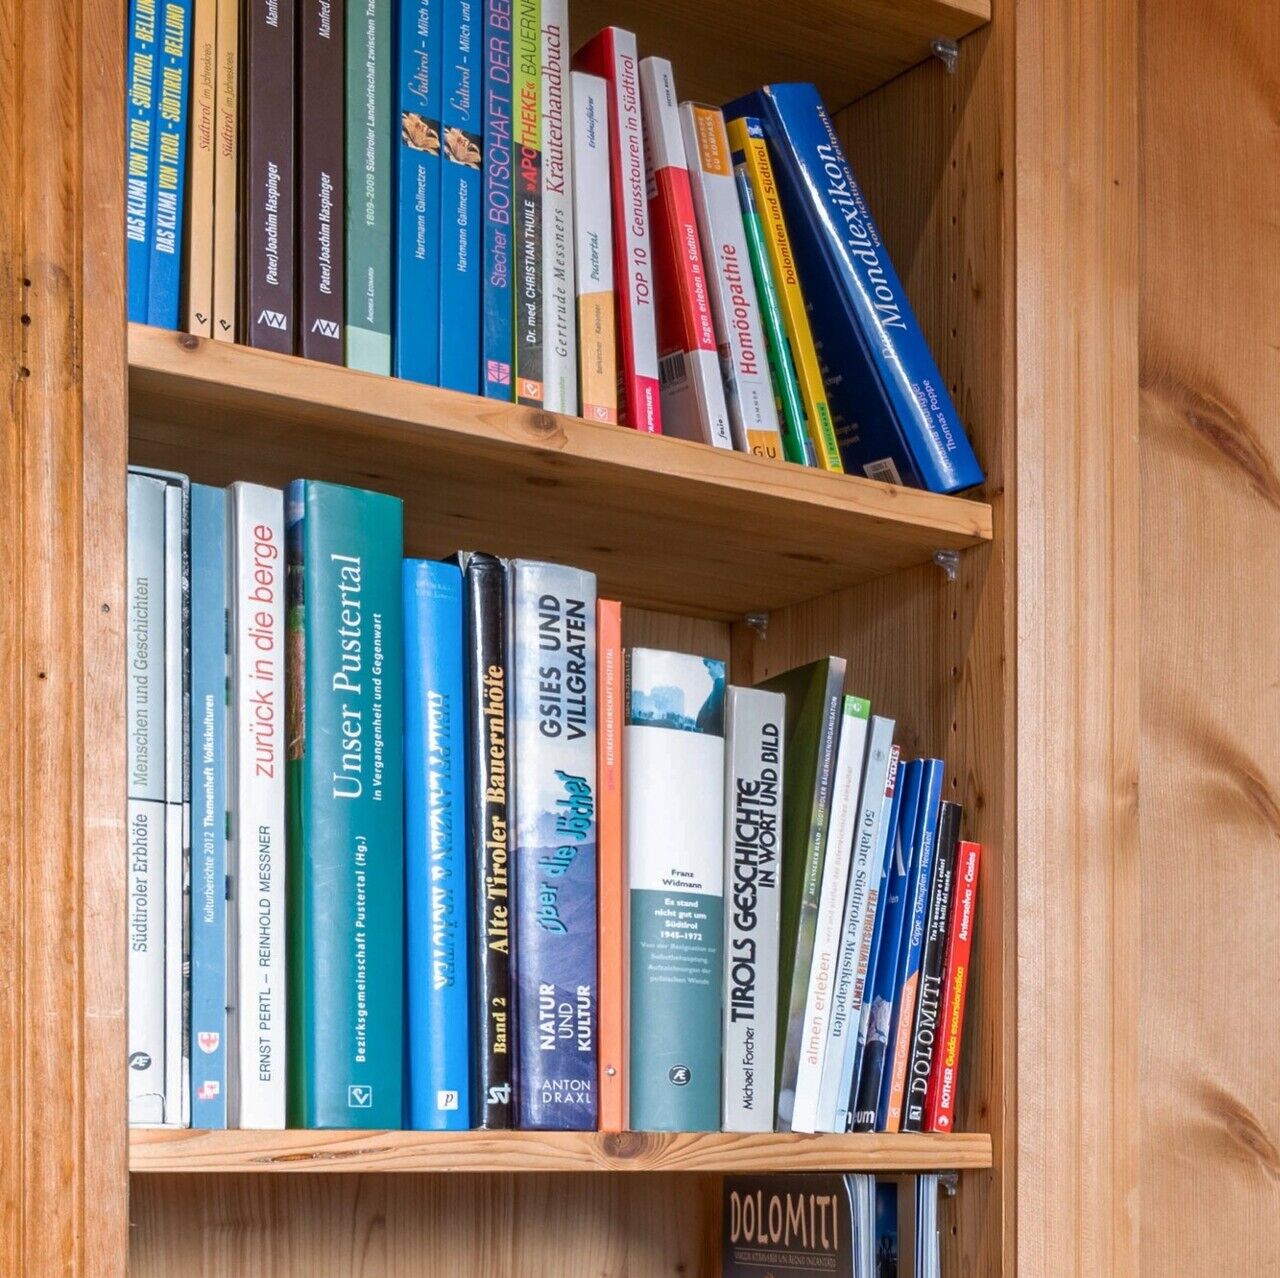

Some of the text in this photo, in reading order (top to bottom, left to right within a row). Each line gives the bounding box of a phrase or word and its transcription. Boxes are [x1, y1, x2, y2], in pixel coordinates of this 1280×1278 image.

[129, 54, 152, 217] KLIMA VON TIROL SÜDTIROL
[156, 4, 185, 254] DAS KLIMA VON TIROL SÜDTIROL BELLUNO
[199, 101, 211, 152] Südtirol
[221, 109, 234, 160] Südtirol
[366, 62, 376, 127] Landwirtschaft
[408, 51, 429, 259] Hartmann Gallmetzer Südtirol
[450, 24, 471, 271] Hartmann Gallmetzer Südtirol Milch
[542, 24, 567, 196] Kräuterhandbuch
[489, 38, 510, 288] Stecher BOTSCHAFT DER
[621, 52, 650, 305] TOP 10 Genusstouren in Südtirol
[754, 145, 796, 285] Dolomiten und Südtirol
[815, 104, 882, 248] vom richtigen Zeitpunkt
[266, 162, 280, 286] (Pater) Joachim Haspinger
[319, 173, 333, 294] (Pater) Joachim Haspinger
[525, 201, 537, 343] Dr. med. CHRISTIAN THUILE
[553, 208, 567, 281] Messners
[587, 230, 600, 281] Pustertal
[685, 223, 713, 343] Sagen erleben in Südtirol
[815, 144, 907, 331] Mondlexikon
[553, 288, 569, 358] Gertrude
[721, 244, 758, 376] Homöopathie
[921, 379, 944, 411] Poppe
[935, 413, 958, 452] Thomas
[133, 577, 149, 787] Menschen und Geschichten
[249, 523, 279, 780] zurück in die berge
[331, 553, 362, 799] Unser Pustertal
[372, 613, 384, 801] in Vergangenheit und Gegenwart
[538, 594, 562, 738] GSIES UND
[565, 598, 587, 741] VILLGRATEN
[203, 695, 215, 923] Kulturberichte 2012 Themenheft Volkskulturen
[482, 665, 509, 1054] Band 2 Alte Tiroler Bauernhöfe
[536, 770, 593, 935] Über die Jöcher
[758, 723, 780, 889] IN WORT UND BILD
[855, 831, 871, 867] Jahre
[861, 809, 875, 828] 50
[132, 814, 148, 953] Südtiroler Erbhöfe
[654, 908, 693, 919] nicht gut
[662, 878, 703, 889] Widmann
[664, 898, 699, 908] Es stand
[671, 869, 694, 878] Franz
[845, 868, 868, 936] Südtiroler
[911, 919, 923, 947] Grippe
[259, 825, 271, 1082] ERNST PERTL REINHOLD MESSNER
[355, 836, 368, 1063] Bezirksgemeinschaft Pustertal (Hg.)
[731, 777, 761, 1111] Michael Forcher TIROLS GESCHICHTE
[832, 941, 857, 1038] Musikkapellen
[850, 978, 865, 1011] ALMEN
[539, 984, 556, 1051] NATUR
[559, 1002, 573, 1039] UND
[577, 985, 591, 1052] KULTUR
[805, 952, 832, 1066] almen erleben
[910, 974, 941, 1095] DOLOMITI
[542, 1080, 591, 1091] ANTON
[542, 1091, 591, 1104] DRAXL
[941, 1036, 957, 1109] ROTHER Guida
[730, 1190, 838, 1250] DOLOMITI
